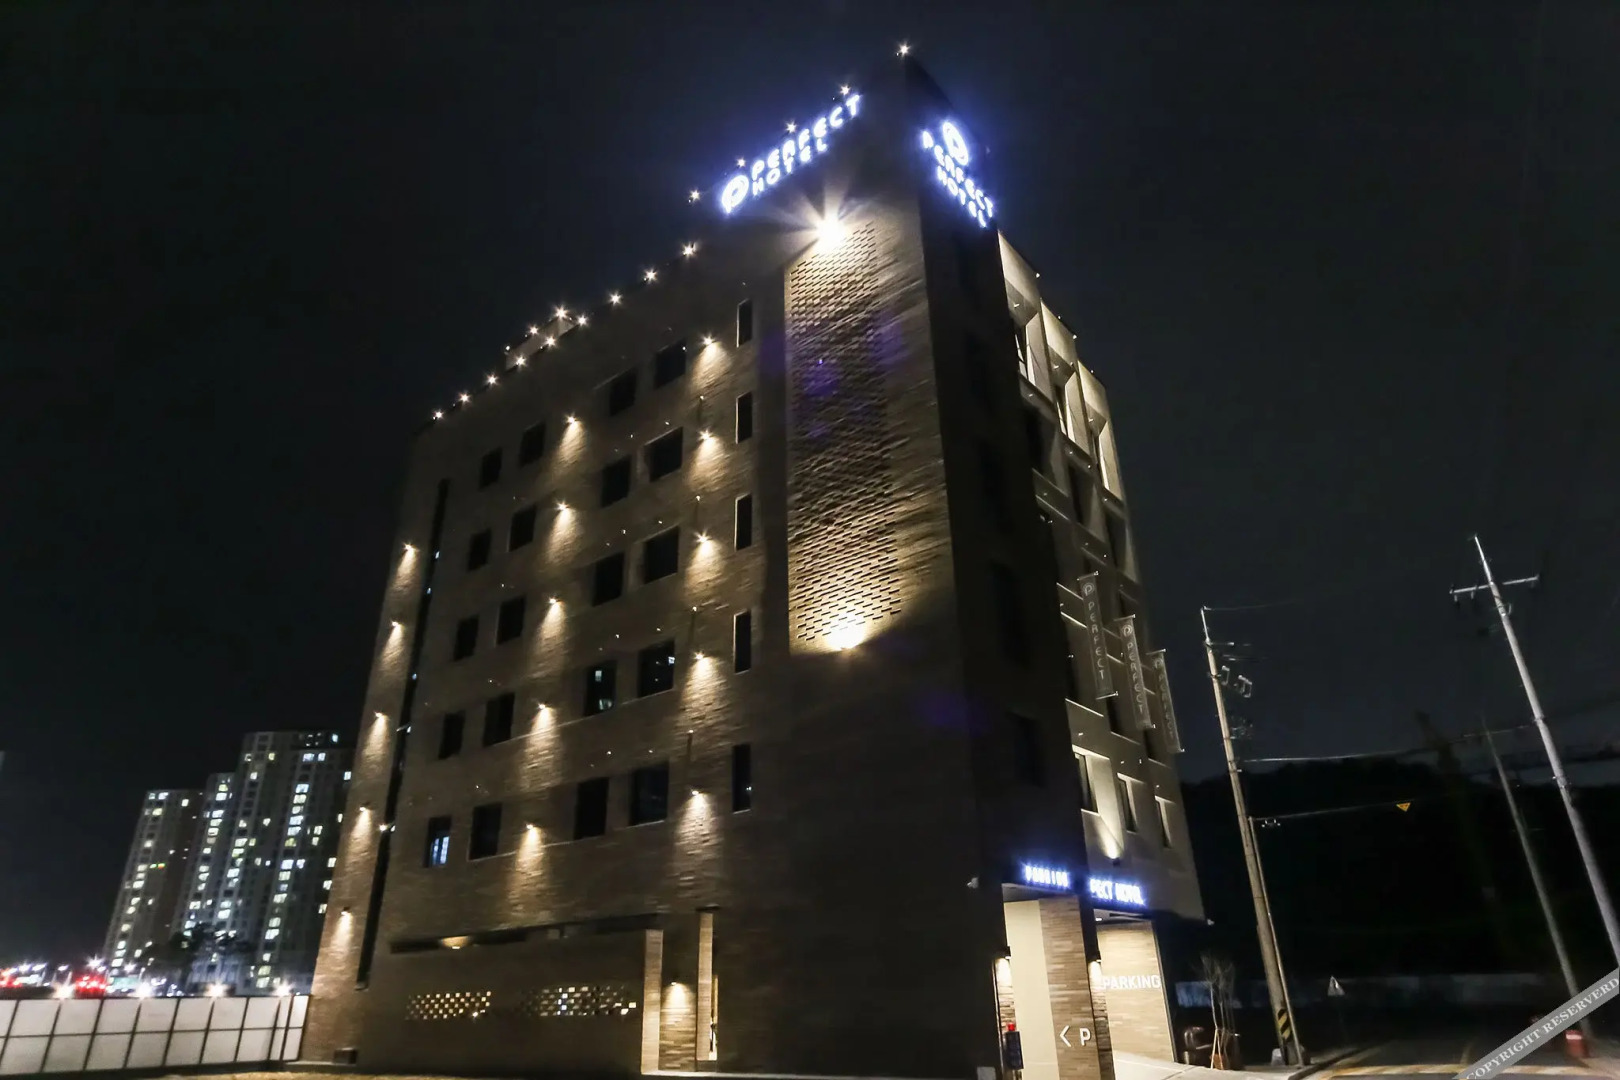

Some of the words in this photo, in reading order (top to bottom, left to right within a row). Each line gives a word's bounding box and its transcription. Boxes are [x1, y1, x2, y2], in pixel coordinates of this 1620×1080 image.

[751, 94, 861, 176] PERFECT
[751, 138, 828, 196] HOTEL
[1087, 601, 1105, 680] PERFECT
[1126, 642, 1144, 714] PERFECT
[1103, 974, 1161, 990] PARKING
[1079, 1027, 1091, 1046] P
